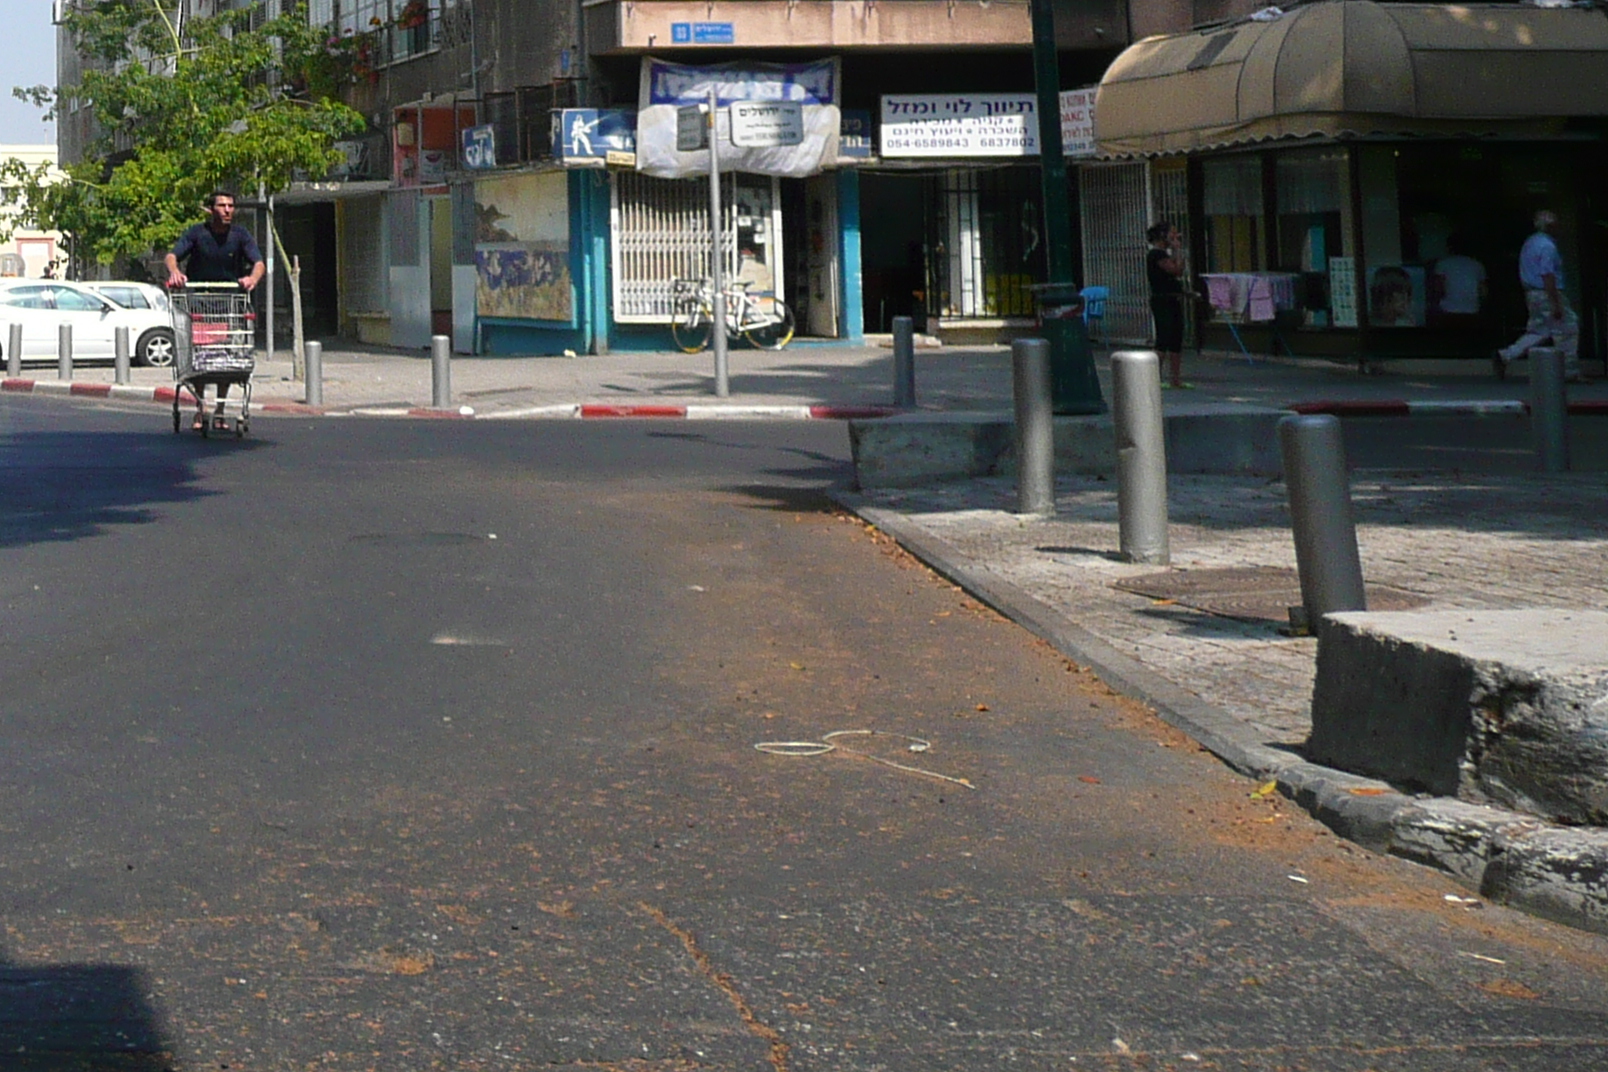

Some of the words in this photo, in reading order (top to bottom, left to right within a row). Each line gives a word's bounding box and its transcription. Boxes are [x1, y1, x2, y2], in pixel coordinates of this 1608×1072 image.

[739, 106, 779, 117] ירושלים
[887, 100, 937, 115] ומזל
[945, 98, 972, 114] לוי
[980, 101, 1034, 116] תיווך
[892, 127, 925, 136] חינם
[978, 126, 1028, 136] השכרה
[980, 137, 1035, 147] 6837802
